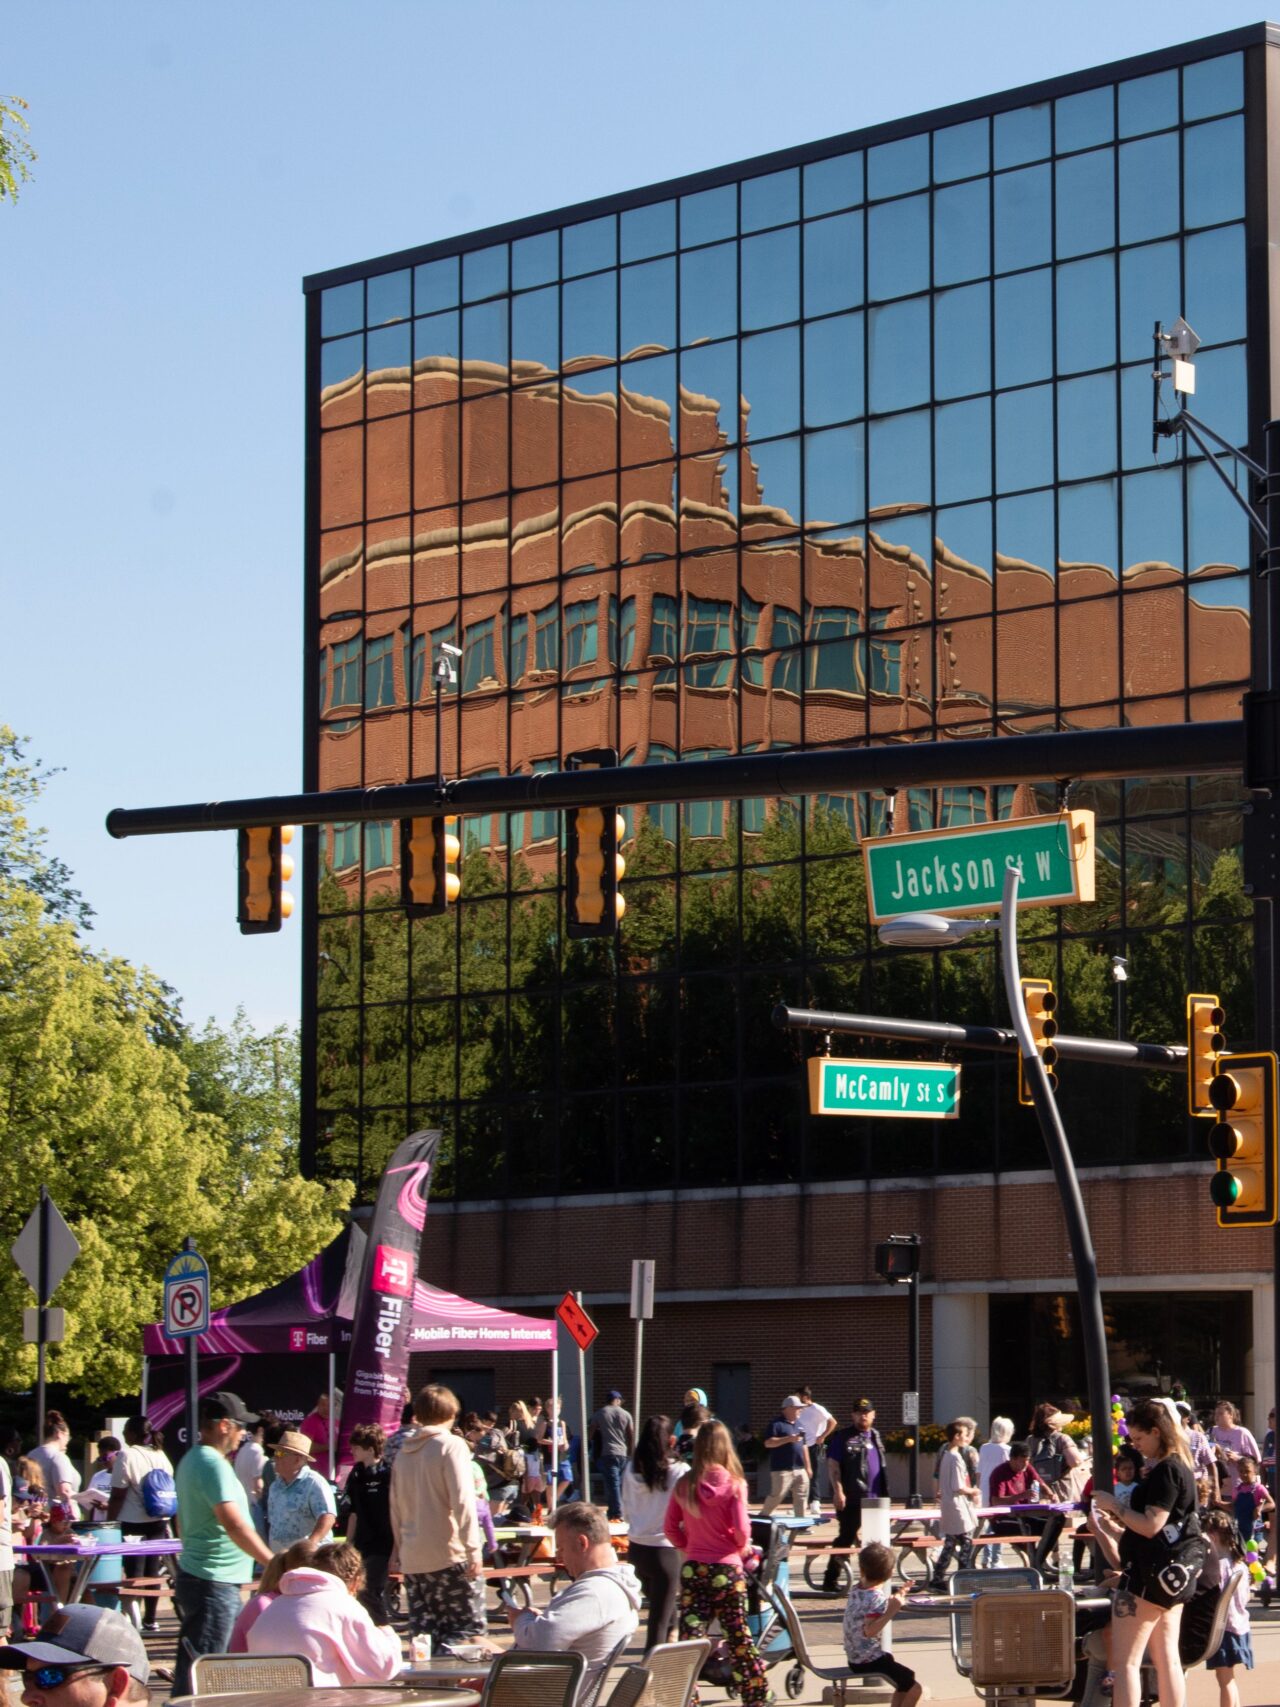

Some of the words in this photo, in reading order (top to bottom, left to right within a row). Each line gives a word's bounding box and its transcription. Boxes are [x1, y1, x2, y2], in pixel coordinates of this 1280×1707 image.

[891, 855, 996, 900] Jackson
[1035, 850, 1051, 882] W
[835, 1073, 910, 1108] McCamly
[917, 1082, 931, 1103] St
[937, 1083, 945, 1103] S
[306, 1332, 329, 1345] Fiber
[374, 1296, 403, 1359] Fiber
[410, 1327, 450, 1340] -Mobile
[451, 1326, 478, 1340] Fiber
[479, 1327, 510, 1340] Home
[511, 1327, 552, 1340] Internet
[267, 1409, 304, 1421] Mobile
